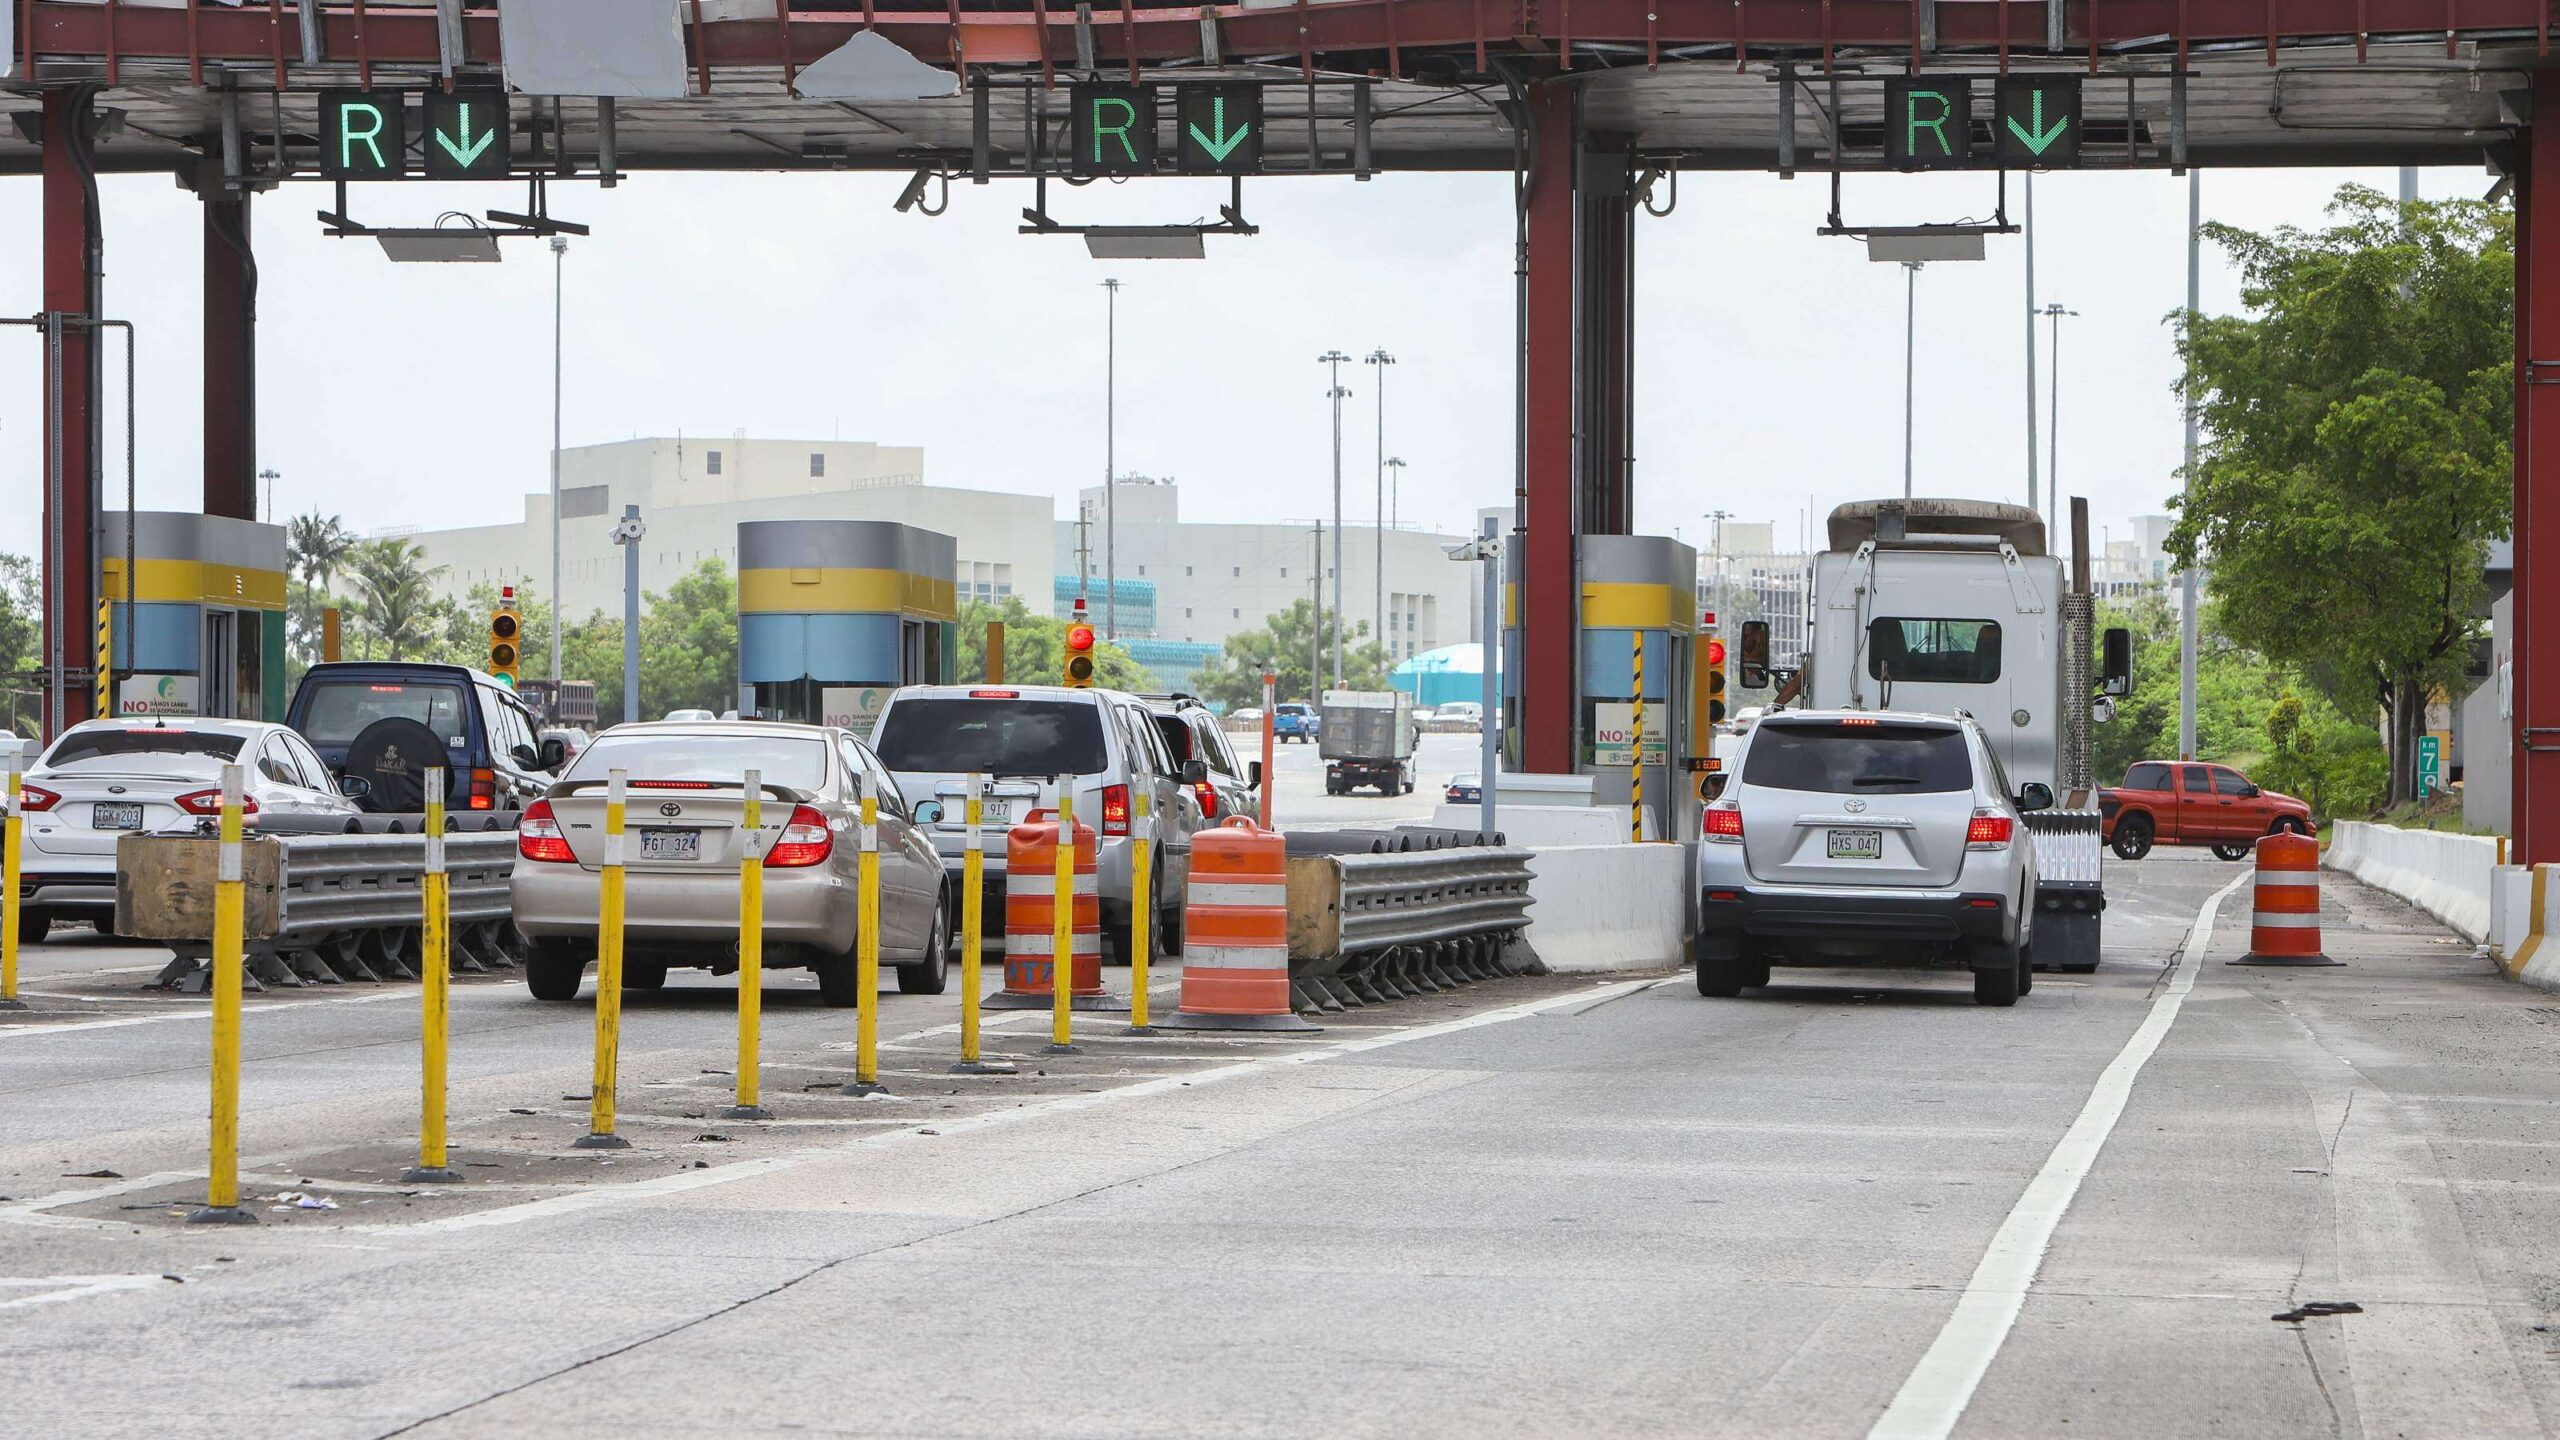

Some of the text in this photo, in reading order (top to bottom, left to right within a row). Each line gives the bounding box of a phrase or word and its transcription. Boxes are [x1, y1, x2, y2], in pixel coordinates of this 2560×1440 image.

[1908, 90, 1952, 156] R
[341, 103, 386, 168] R
[1093, 97, 1138, 163] R
[123, 701, 148, 712] NO
[827, 714, 851, 726] NO
[1599, 730, 1623, 742] NO
[2422, 741, 2436, 749] km
[375, 755, 406, 769] DAKAR
[2423, 752, 2435, 770] 7
[97, 810, 139, 822] IGK 203
[990, 803, 1008, 816] 917
[643, 838, 697, 851] FGT 324
[1831, 837, 1878, 851] HXS 047
